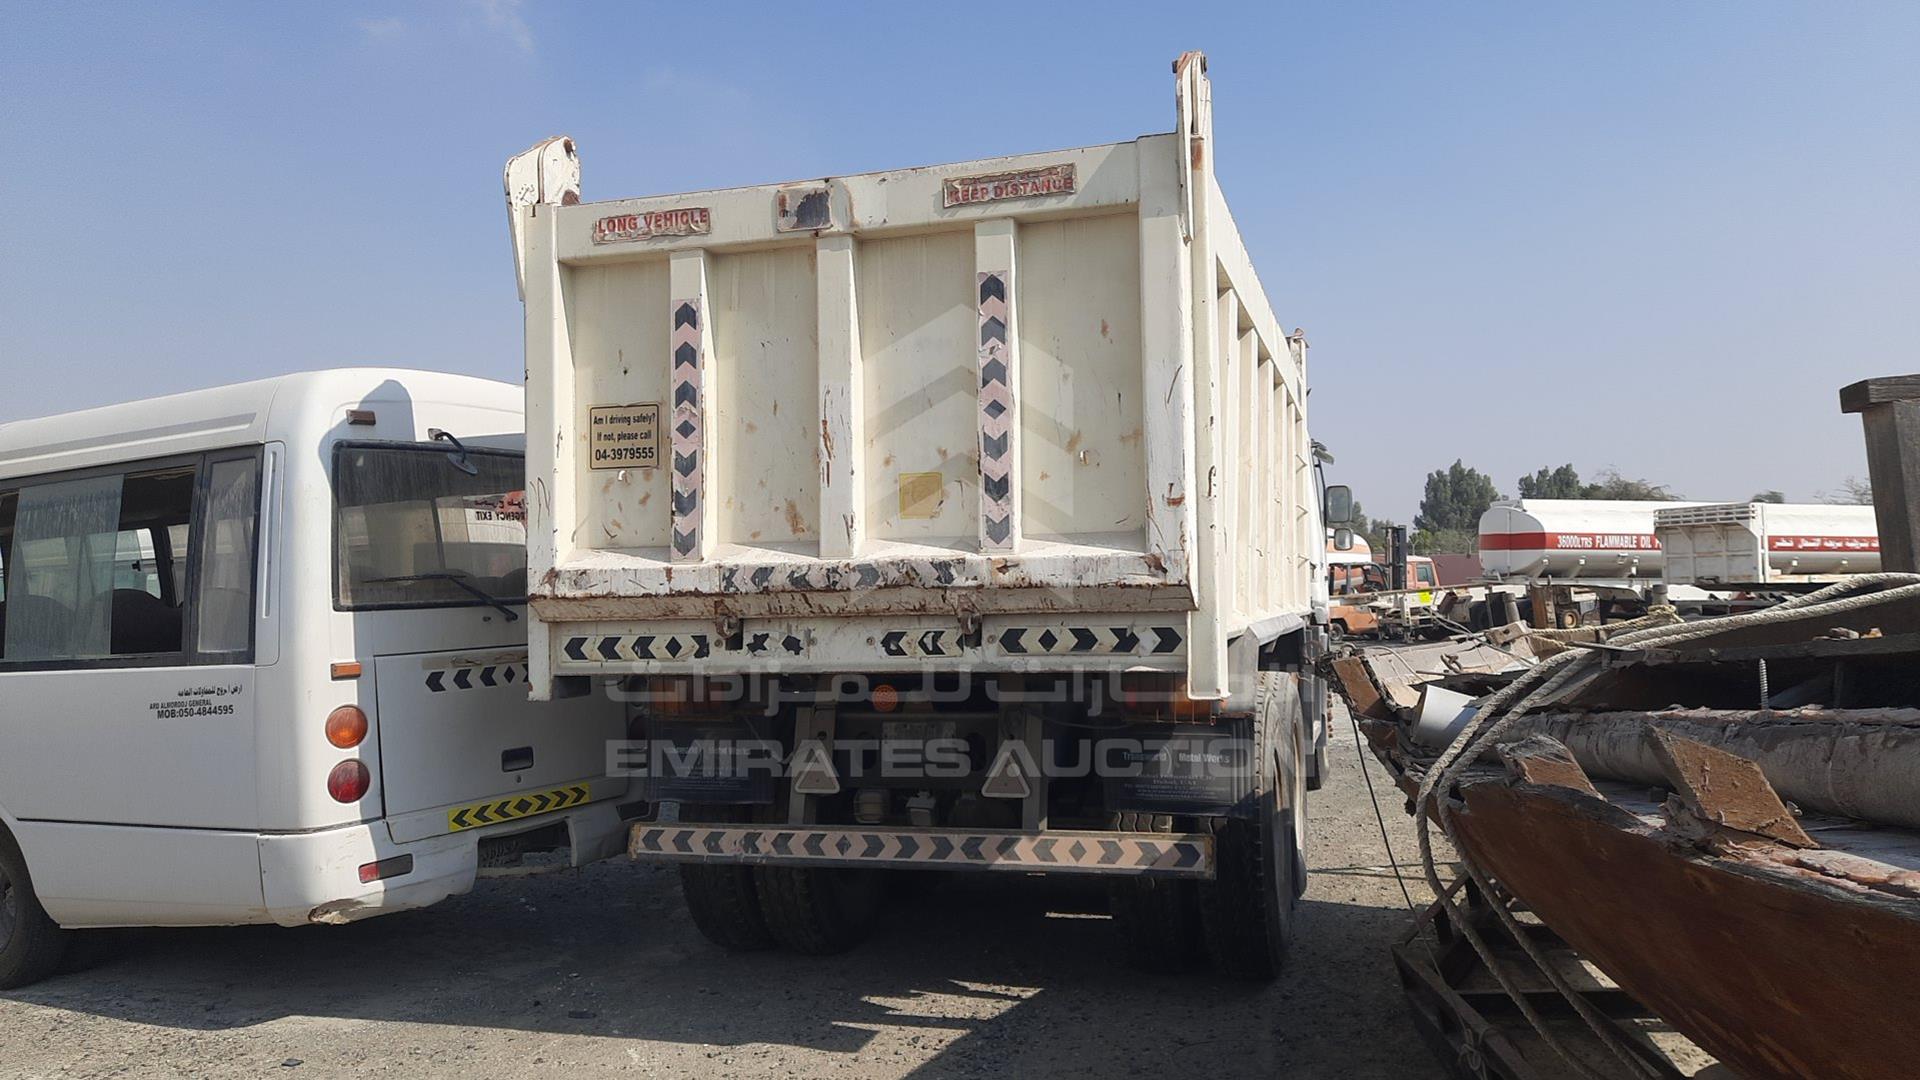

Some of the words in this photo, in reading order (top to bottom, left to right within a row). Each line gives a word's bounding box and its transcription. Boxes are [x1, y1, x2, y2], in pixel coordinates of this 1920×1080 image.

[948, 187, 990, 203] KEEP
[994, 177, 1074, 199] DISTANCE
[597, 216, 638, 234] LONG
[643, 208, 709, 229] VEHICLE
[593, 416, 604, 425] Am
[609, 414, 631, 426] driving
[632, 413, 656, 425] safely?
[597, 432, 602, 441] If
[603, 432, 616, 442] not,
[617, 431, 638, 442] please
[640, 430, 652, 440] call
[595, 447, 654, 461] 04-3979555
[1596, 536, 1637, 548] FLAMMABLE
[1641, 536, 1652, 548] OIL
[157, 704, 234, 719] MOB:050-4844595
[1178, 752, 1201, 762] Metal
